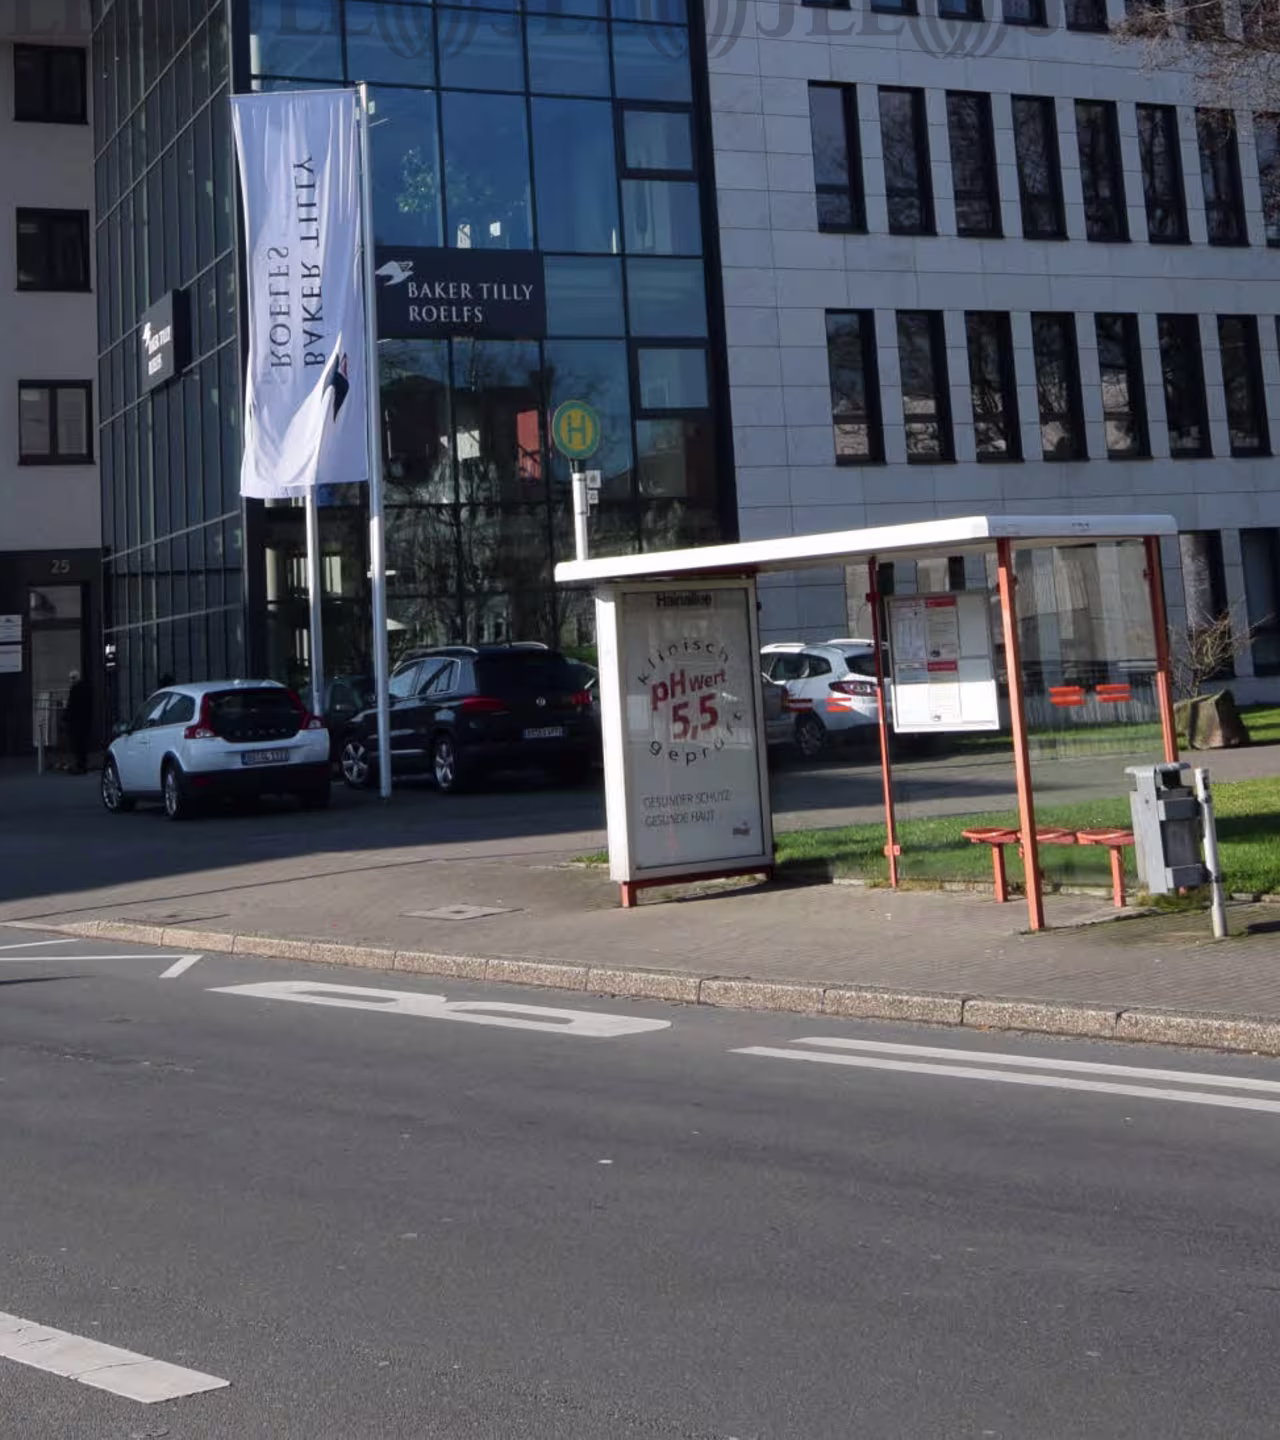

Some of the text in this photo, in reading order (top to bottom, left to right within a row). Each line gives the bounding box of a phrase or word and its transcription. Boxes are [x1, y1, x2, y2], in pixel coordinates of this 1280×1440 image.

[408, 281, 533, 301] BAKER TILLY
[409, 305, 483, 323] ROELFS
[567, 414, 587, 447] H
[50, 559, 70, 574] 25
[637, 636, 729, 686] klinisch
[650, 668, 727, 712] pH Wert
[672, 692, 719, 741] 5,5
